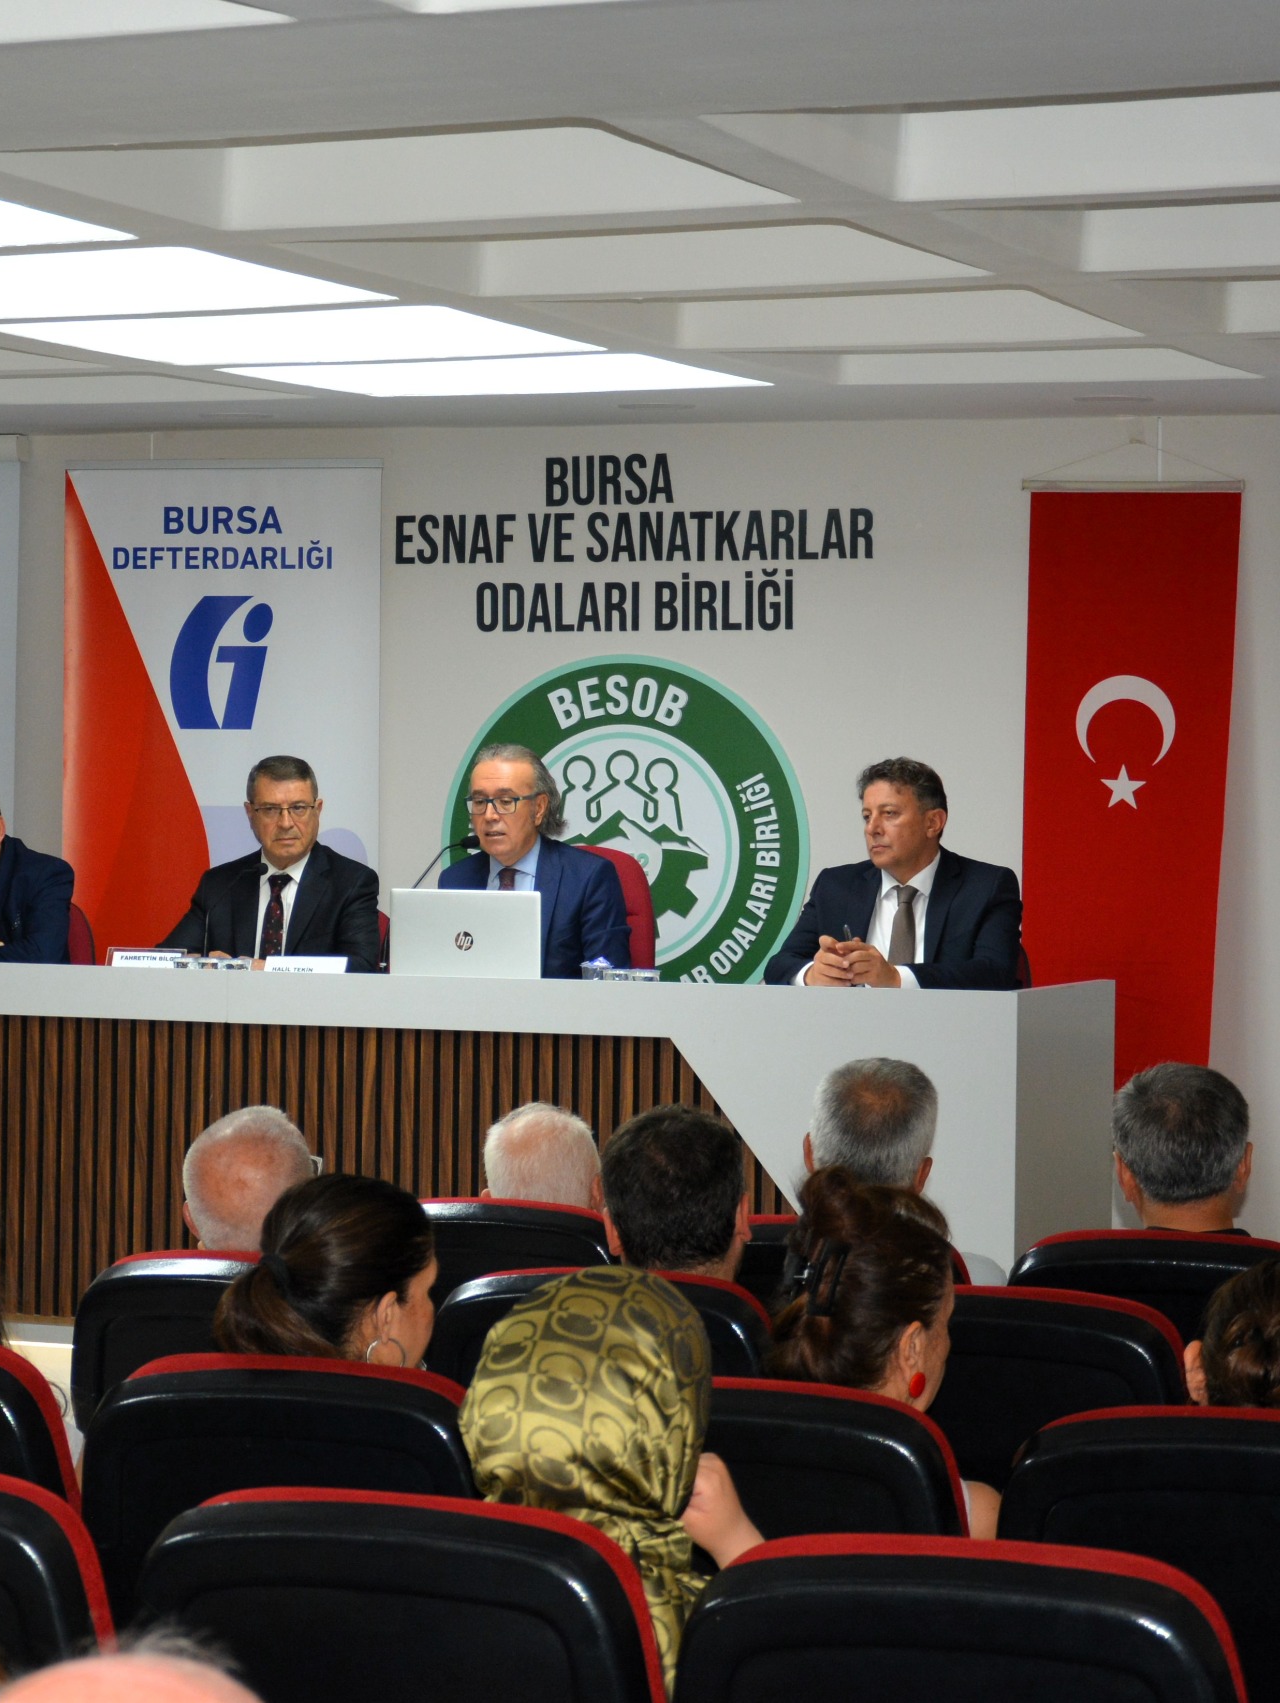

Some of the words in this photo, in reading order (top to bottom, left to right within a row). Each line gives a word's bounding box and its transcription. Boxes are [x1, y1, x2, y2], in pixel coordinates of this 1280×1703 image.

[545, 453, 674, 506] BURSA
[163, 506, 282, 535] BURSA
[395, 514, 516, 565] ESNAF
[528, 512, 575, 563] VE
[586, 507, 874, 562] SANATKARLAR
[112, 540, 333, 570] DEFTERDARLIĞI
[476, 580, 640, 633] ODALARI
[654, 568, 794, 632] BİRLİĞİ
[547, 674, 689, 730] BESOB
[735, 772, 781, 868] BİRLİĞİ
[709, 873, 779, 975] ODALARI
